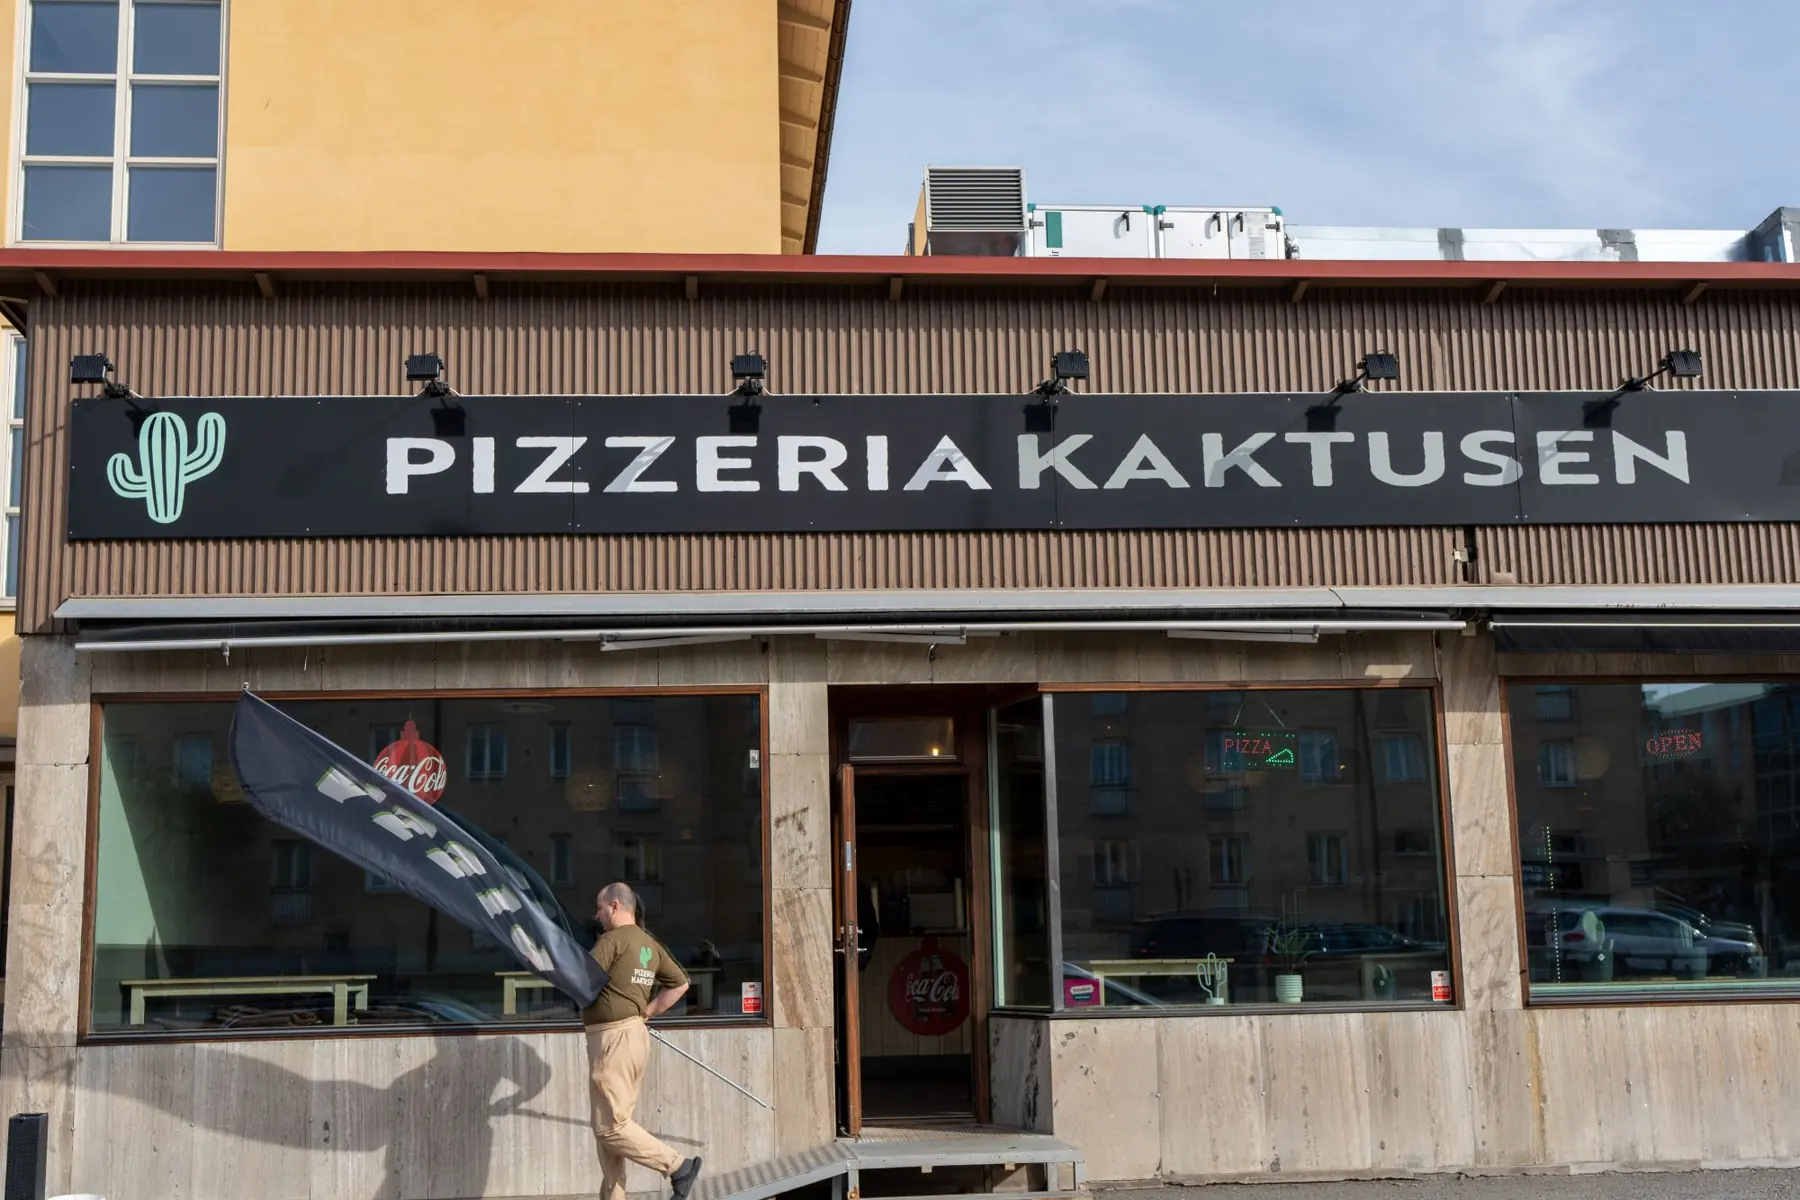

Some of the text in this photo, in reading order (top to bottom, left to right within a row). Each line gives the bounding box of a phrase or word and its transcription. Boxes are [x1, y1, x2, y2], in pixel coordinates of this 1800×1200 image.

[386, 430, 1690, 493] PIZZERIA KAKTUSEN
[1224, 739, 1273, 754] PIZZA
[1646, 732, 1702, 755] OPEN
